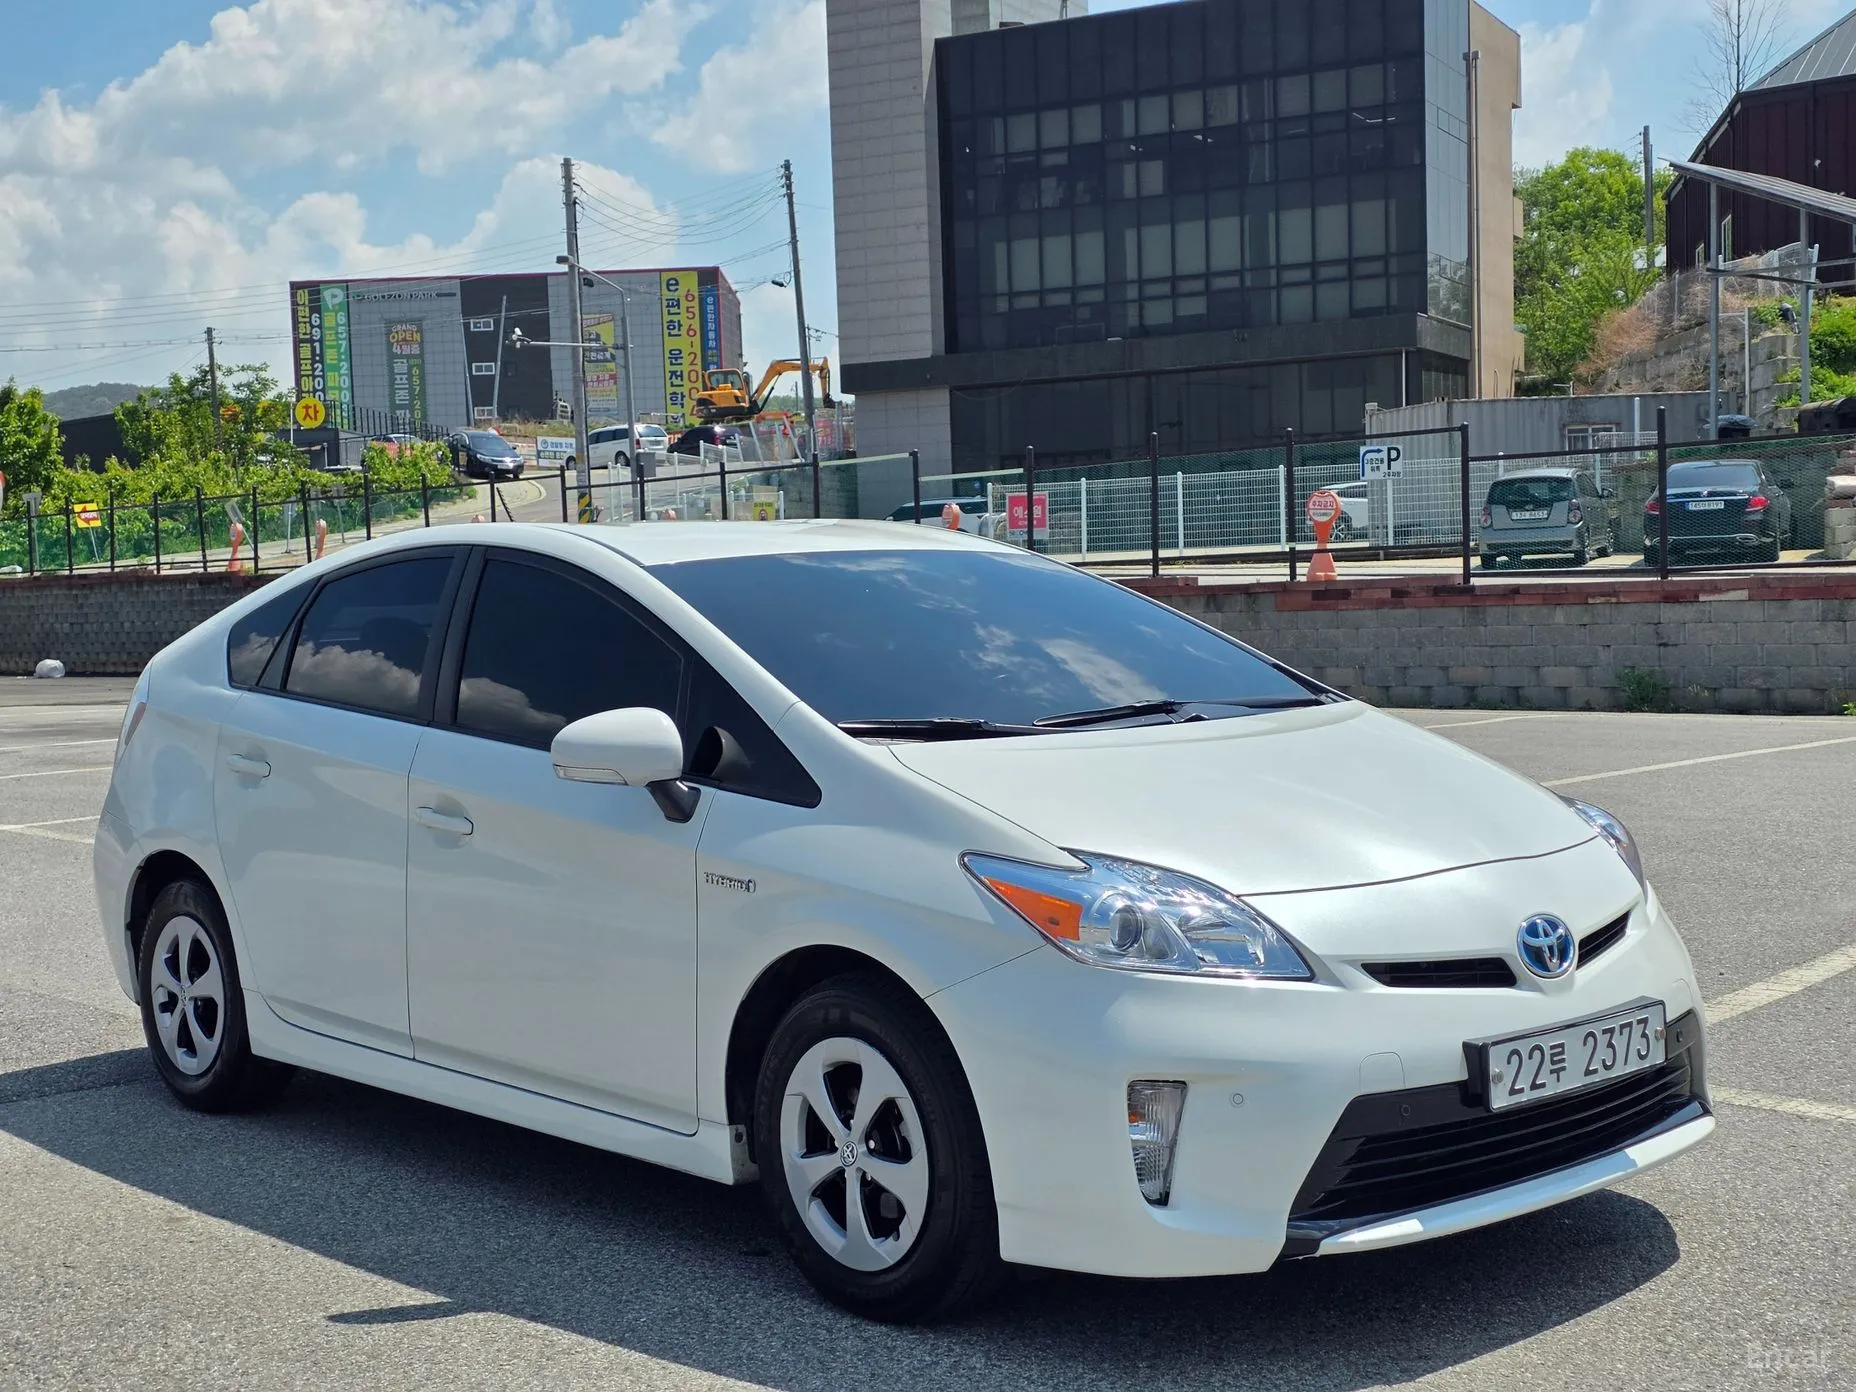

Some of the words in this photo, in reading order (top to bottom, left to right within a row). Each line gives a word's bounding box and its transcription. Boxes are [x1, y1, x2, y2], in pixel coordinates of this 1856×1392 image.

[296, 288, 311, 338] 이편한
[412, 290, 438, 300] PARK
[666, 277, 682, 337] e편한
[324, 311, 338, 364] 골프존
[389, 331, 420, 343] OPEN
[393, 359, 409, 404] 골프존
[302, 403, 320, 421] 차
[1387, 447, 1400, 470] P
[1506, 1041, 1567, 1097] 22루
[1582, 1015, 1651, 1078] 2373
